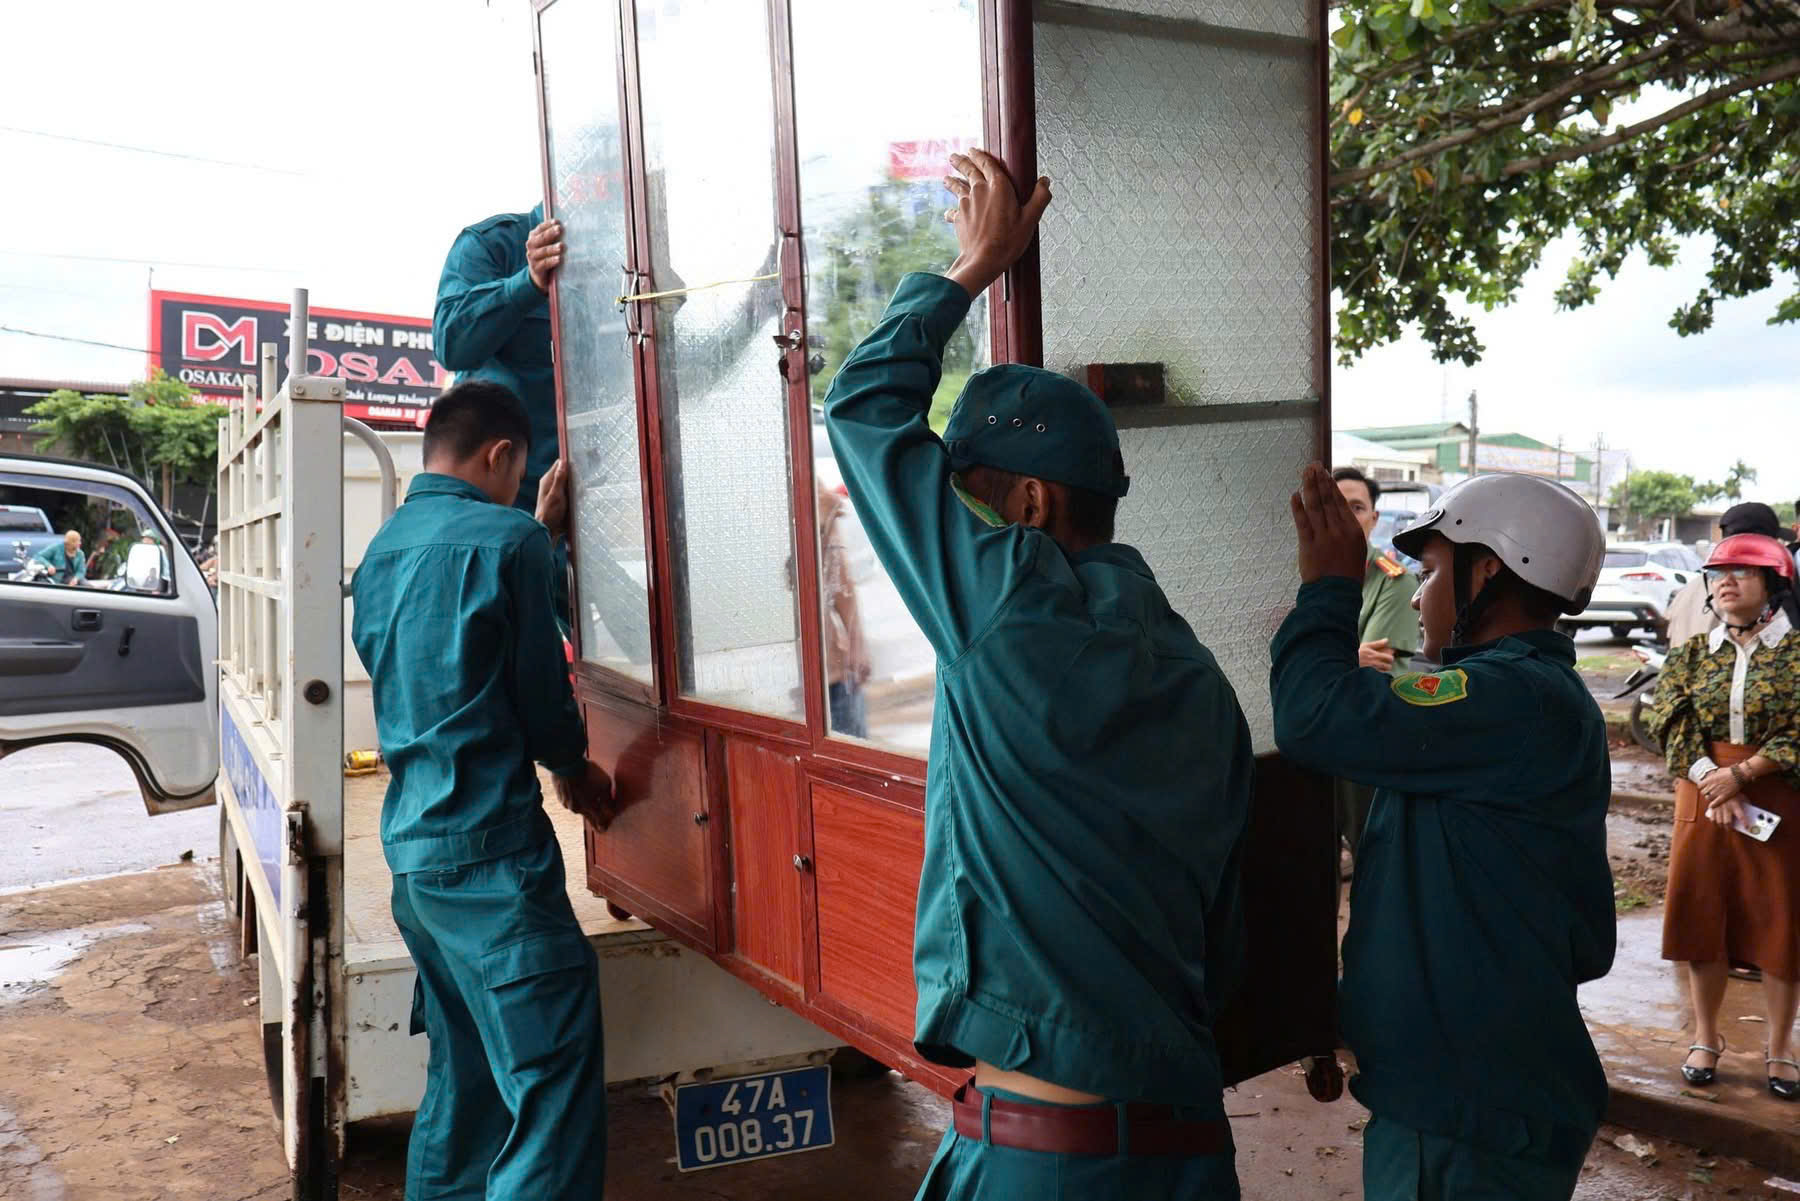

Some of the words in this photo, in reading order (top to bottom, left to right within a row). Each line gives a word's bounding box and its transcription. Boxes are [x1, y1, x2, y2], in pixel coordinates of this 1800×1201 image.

[324, 322, 384, 347] ĐIỆN
[179, 368, 257, 387] OSAKA
[720, 1076, 787, 1116] 47A
[694, 1109, 815, 1162] 008.37
